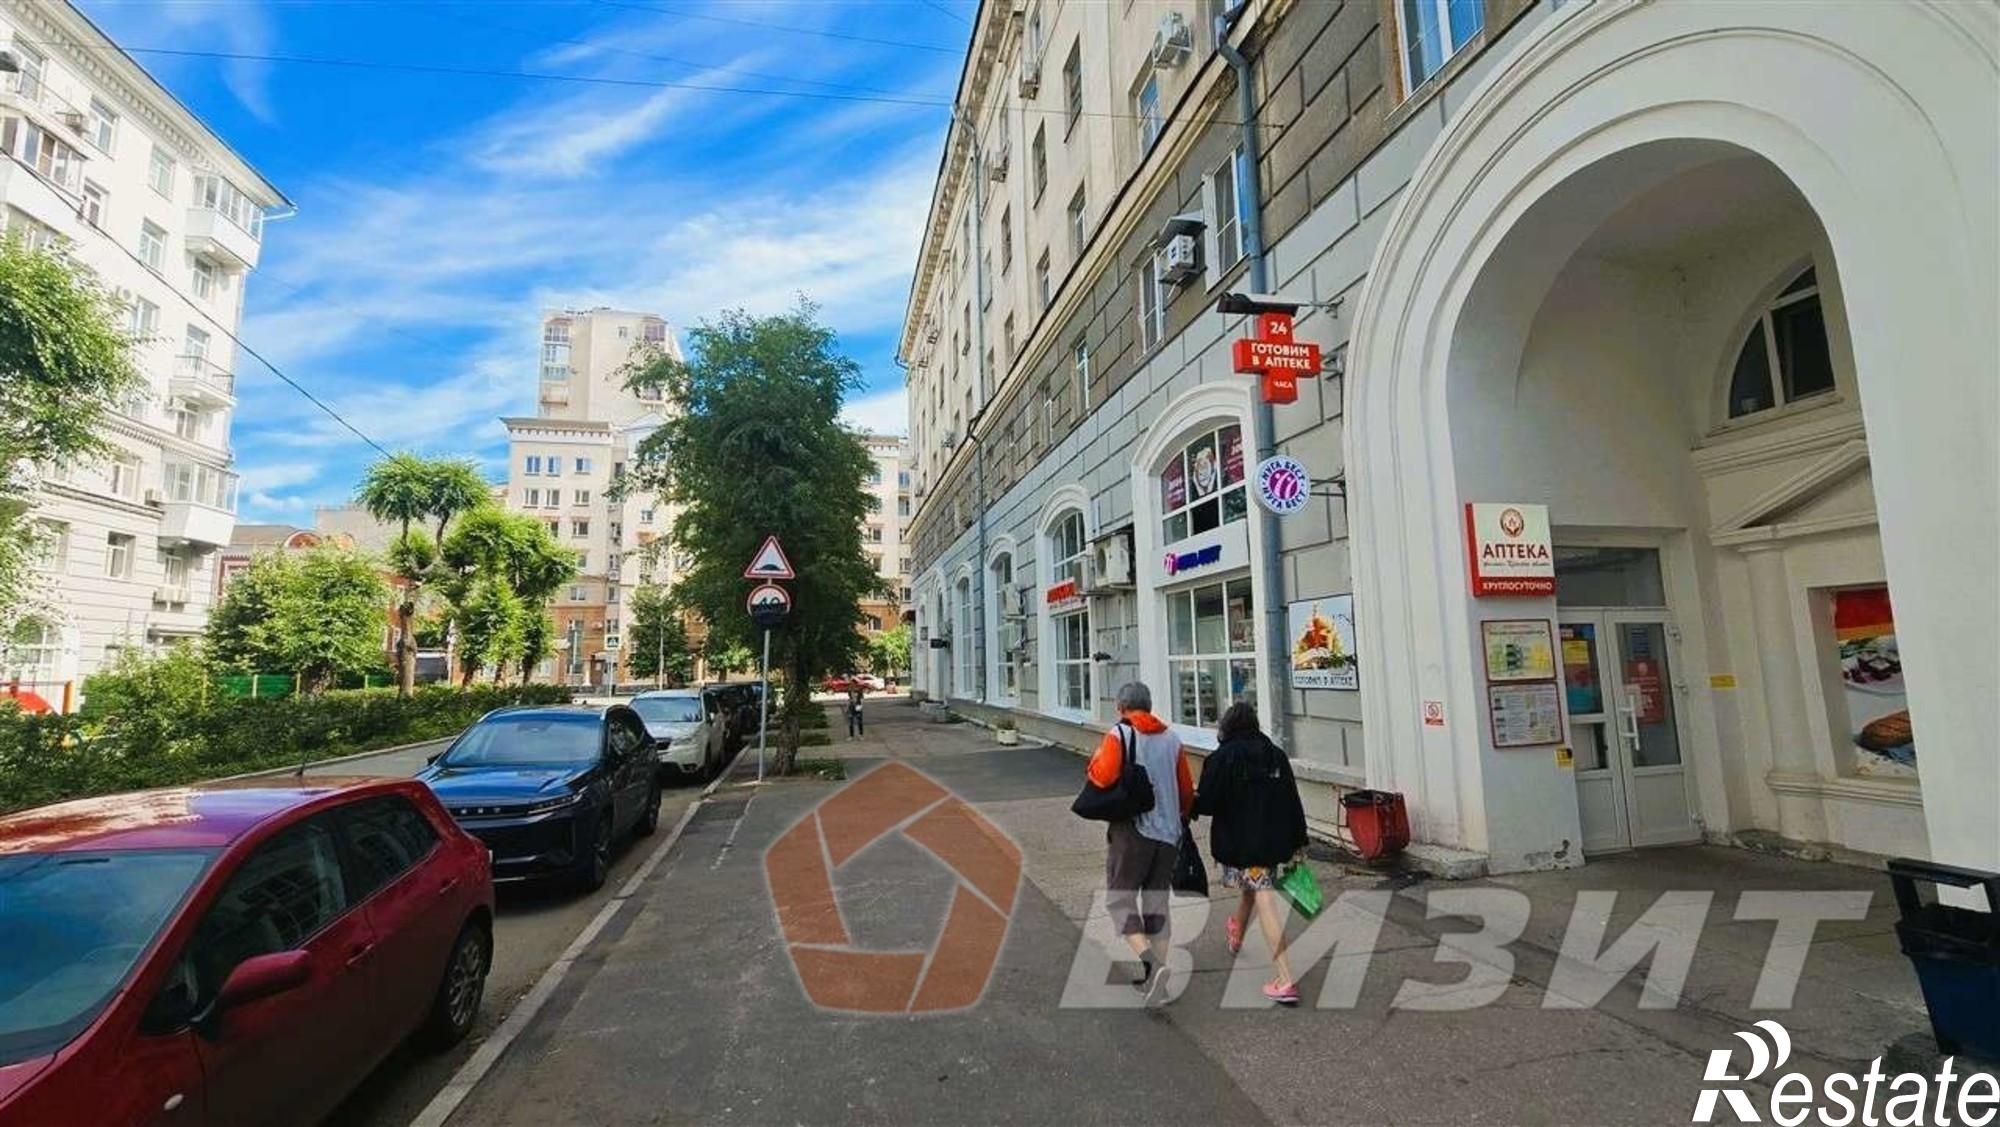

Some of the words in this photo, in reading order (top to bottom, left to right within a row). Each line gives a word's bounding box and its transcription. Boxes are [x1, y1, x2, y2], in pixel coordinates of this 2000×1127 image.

[1270, 321, 1288, 335] 24
[1251, 343, 1310, 357] ГОТОВИМ
[1252, 355, 1260, 366] В
[1264, 356, 1312, 370] АПТЕКЕ
[1273, 381, 1294, 389] ЧАСА
[1482, 543, 1550, 559] АПТЕКА
[1482, 581, 1554, 591] КРУГЛОСУТОЧНО
